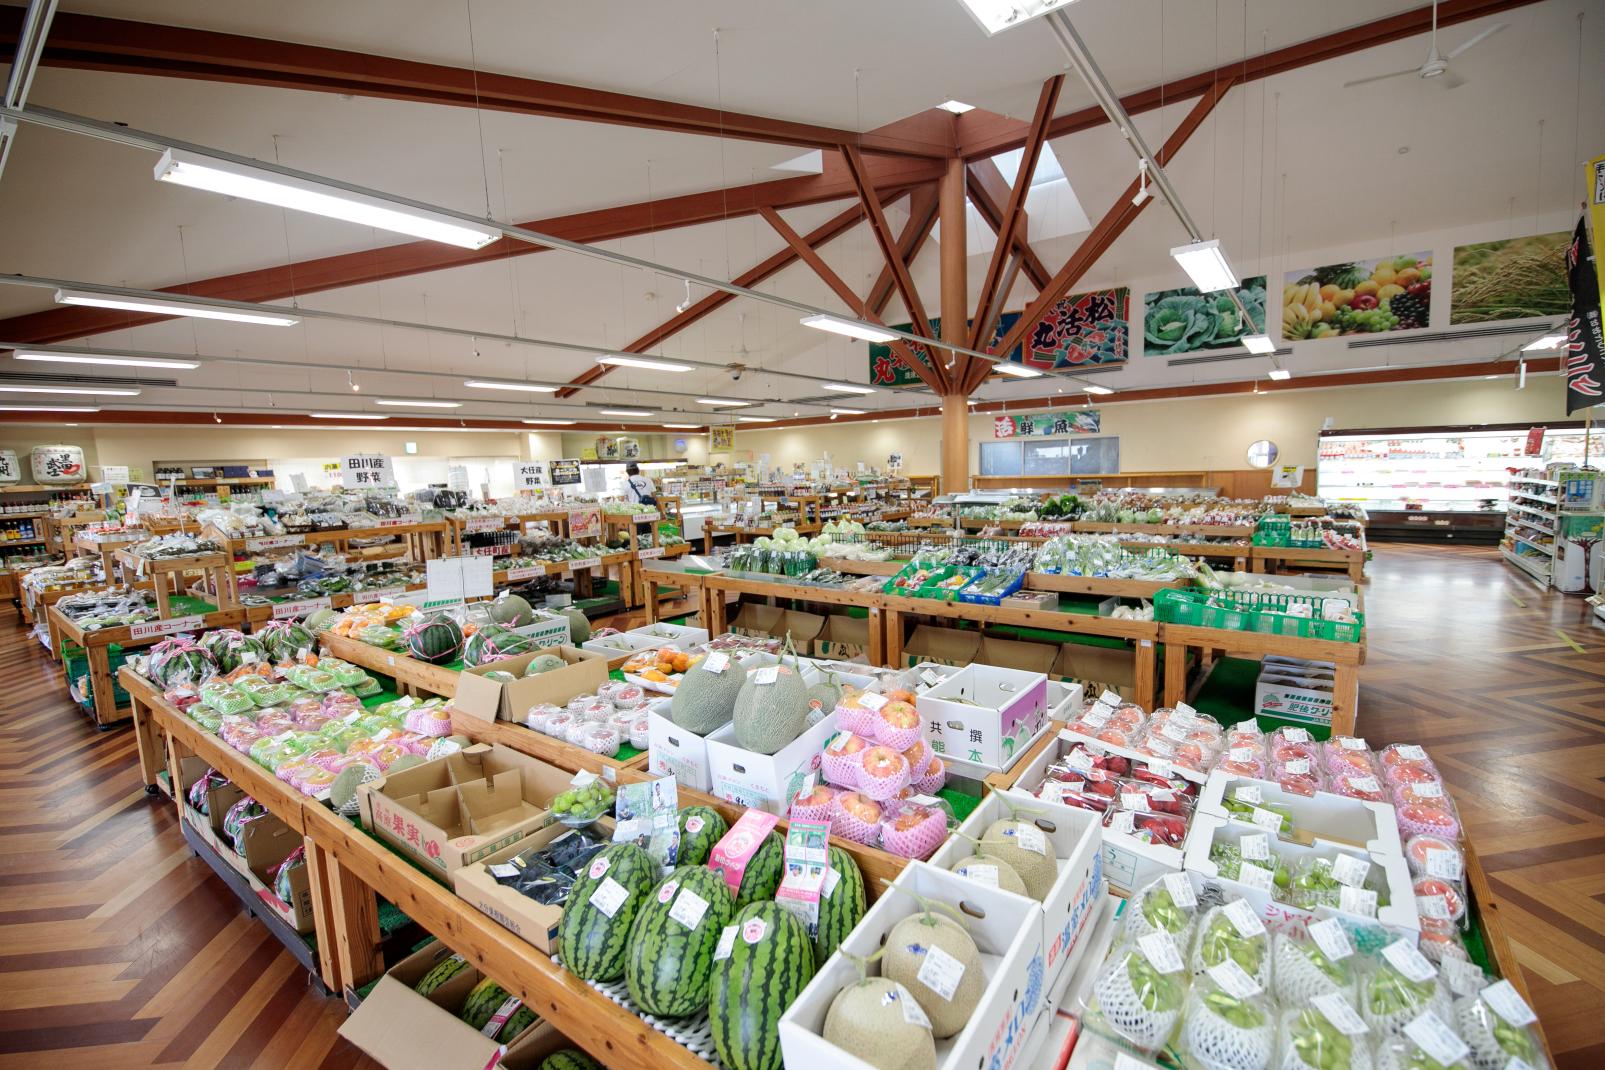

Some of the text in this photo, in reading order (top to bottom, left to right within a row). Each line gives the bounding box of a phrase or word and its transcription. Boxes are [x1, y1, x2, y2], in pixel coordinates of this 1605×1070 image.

[349, 458, 385, 469] 田川産
[356, 472, 381, 483] 野菜
[133, 620, 202, 634] 田川産コーナー
